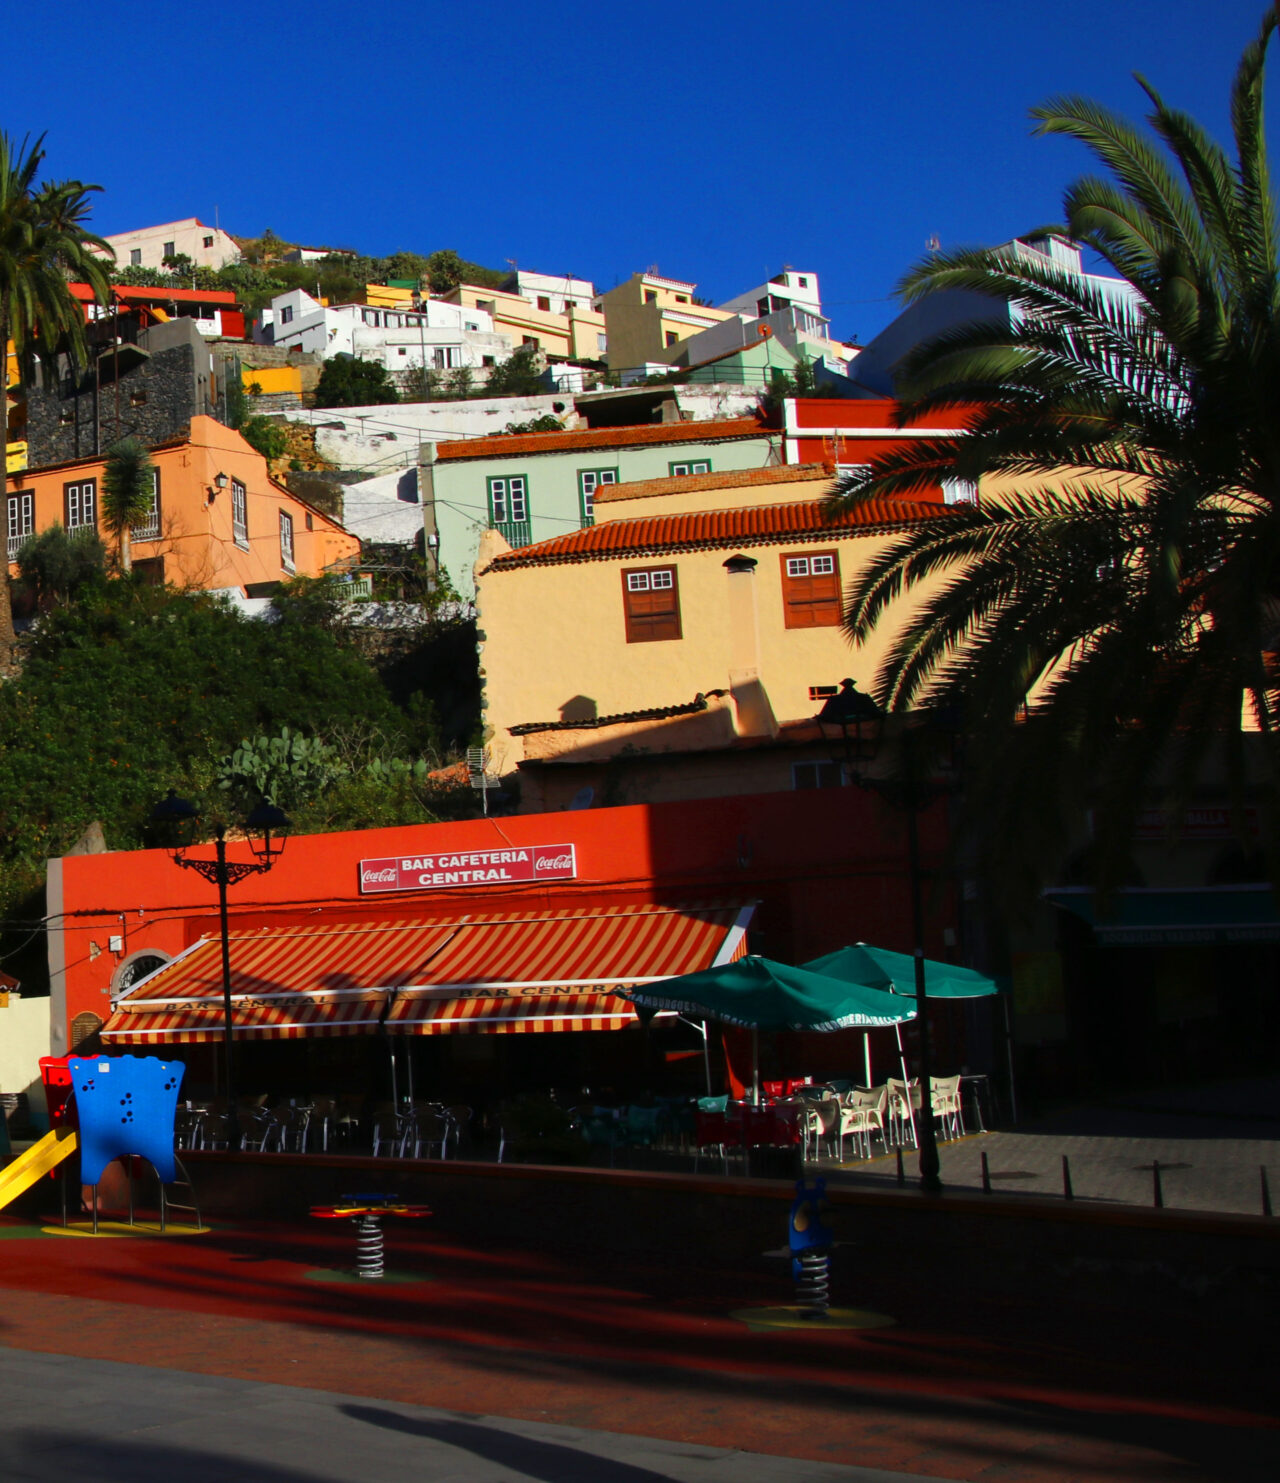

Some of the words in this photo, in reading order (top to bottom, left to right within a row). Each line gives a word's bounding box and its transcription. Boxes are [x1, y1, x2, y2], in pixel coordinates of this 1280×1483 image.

[402, 857, 434, 871] BAR
[438, 850, 529, 868] CAFETERIA
[535, 854, 573, 871] Coca-Cola
[418, 868, 512, 886] CENTRAL
[459, 988, 510, 998] BAR
[164, 1002, 210, 1011] BAR
